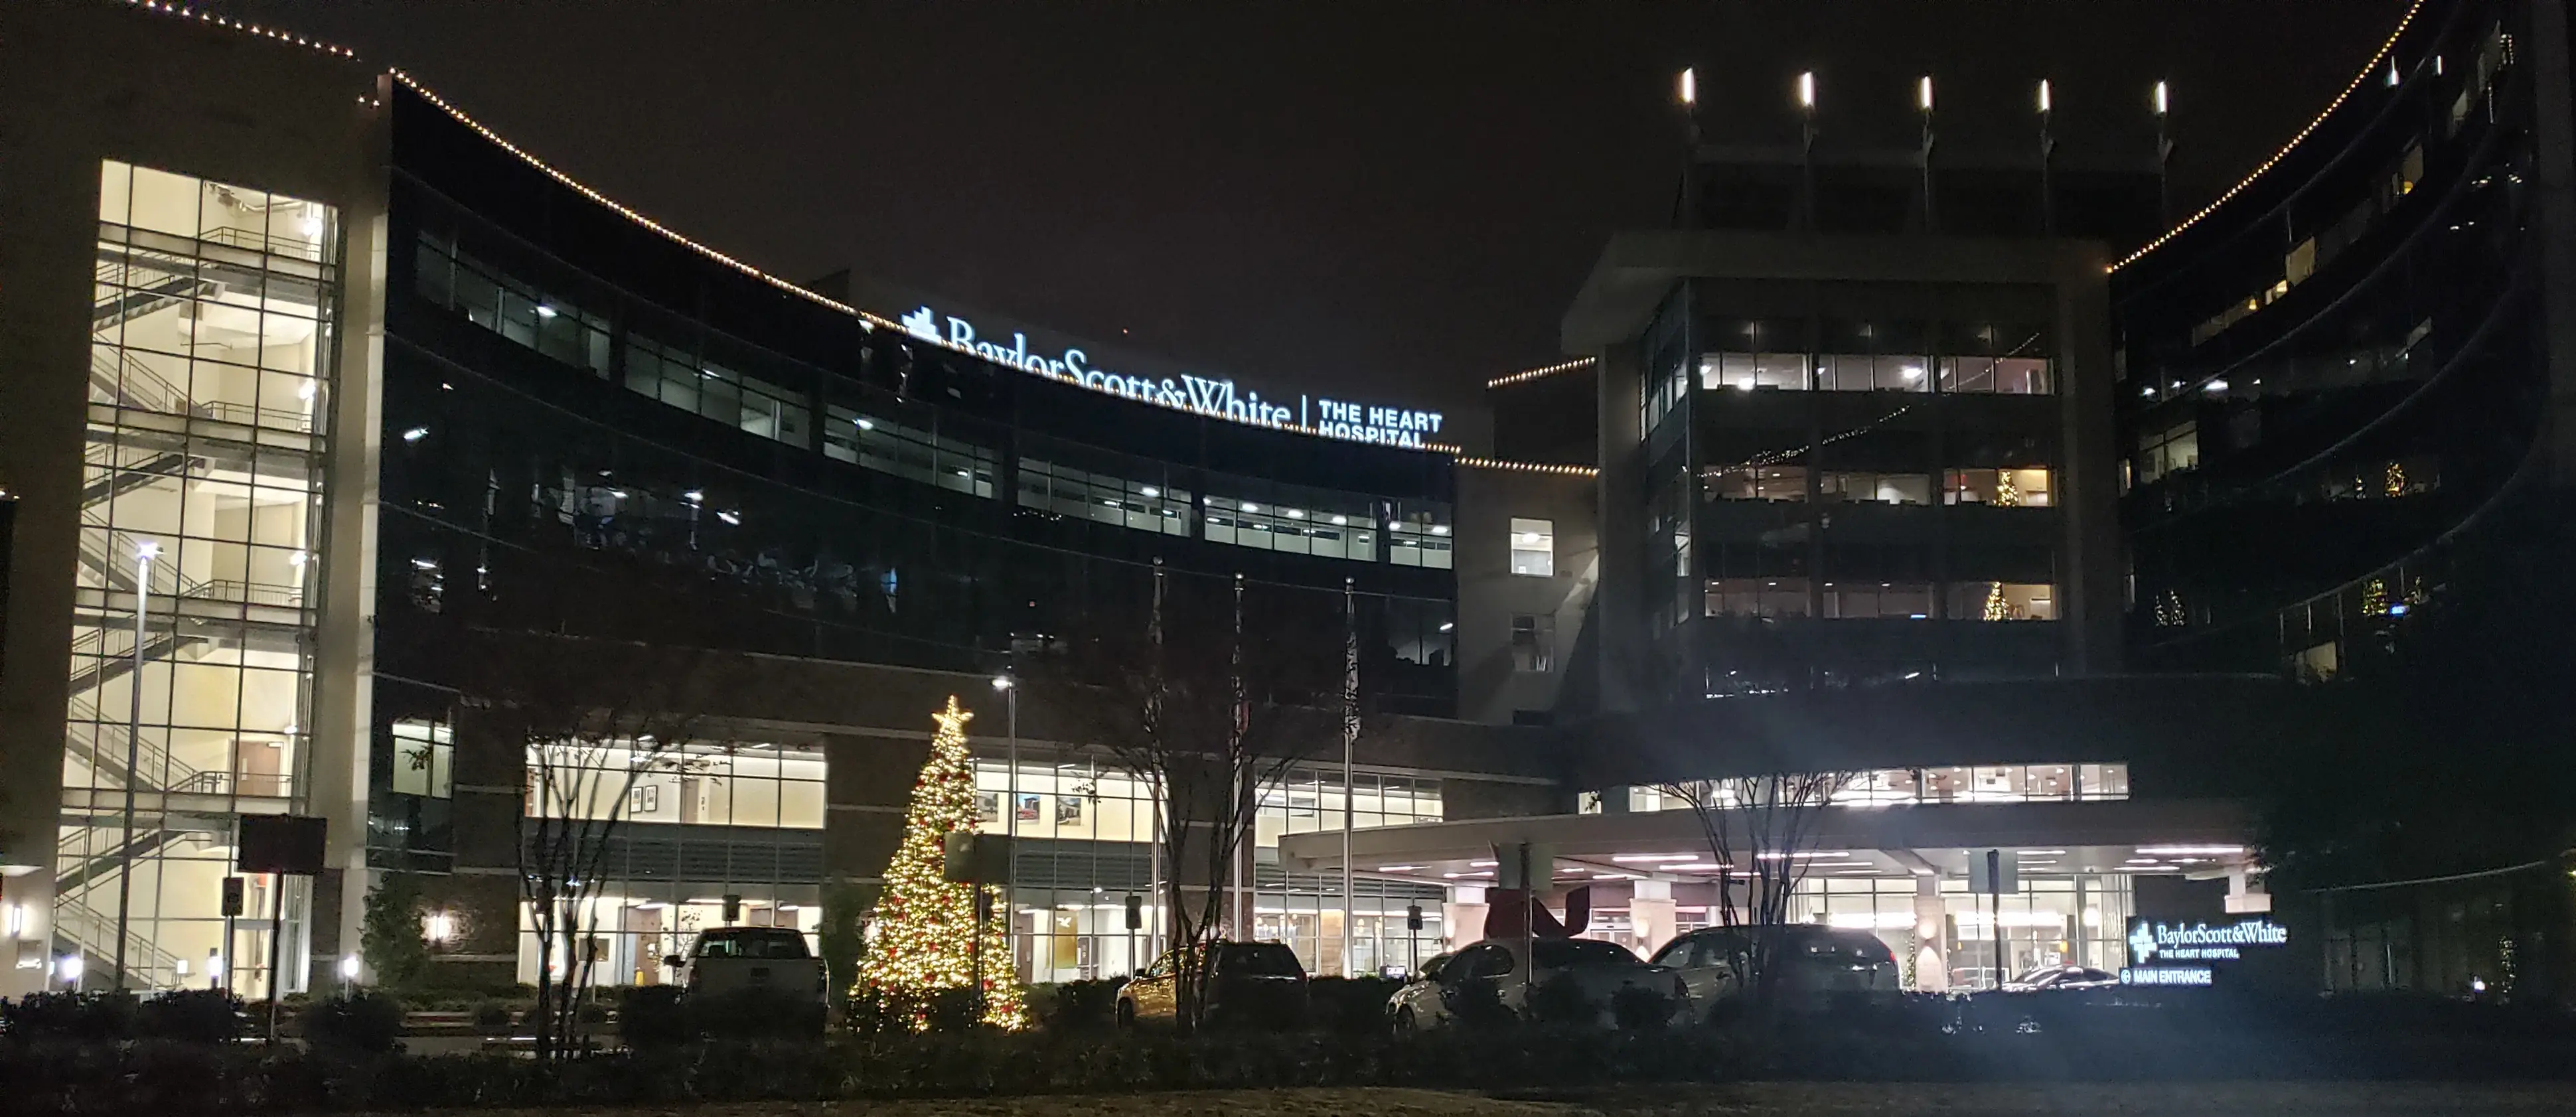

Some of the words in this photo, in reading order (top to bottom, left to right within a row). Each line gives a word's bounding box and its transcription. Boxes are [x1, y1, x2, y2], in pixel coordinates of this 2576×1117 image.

[1318, 400, 1361, 423] THE
[1369, 407, 1442, 433] HEART
[1318, 420, 1426, 449] HOSPITAL
[2159, 949, 2174, 958] THE
[2175, 949, 2199, 958] HEART
[2201, 948, 2240, 958] HOSPITAL
[2133, 970, 2157, 984] MAIN
[2159, 970, 2212, 984] ENTRANCE
